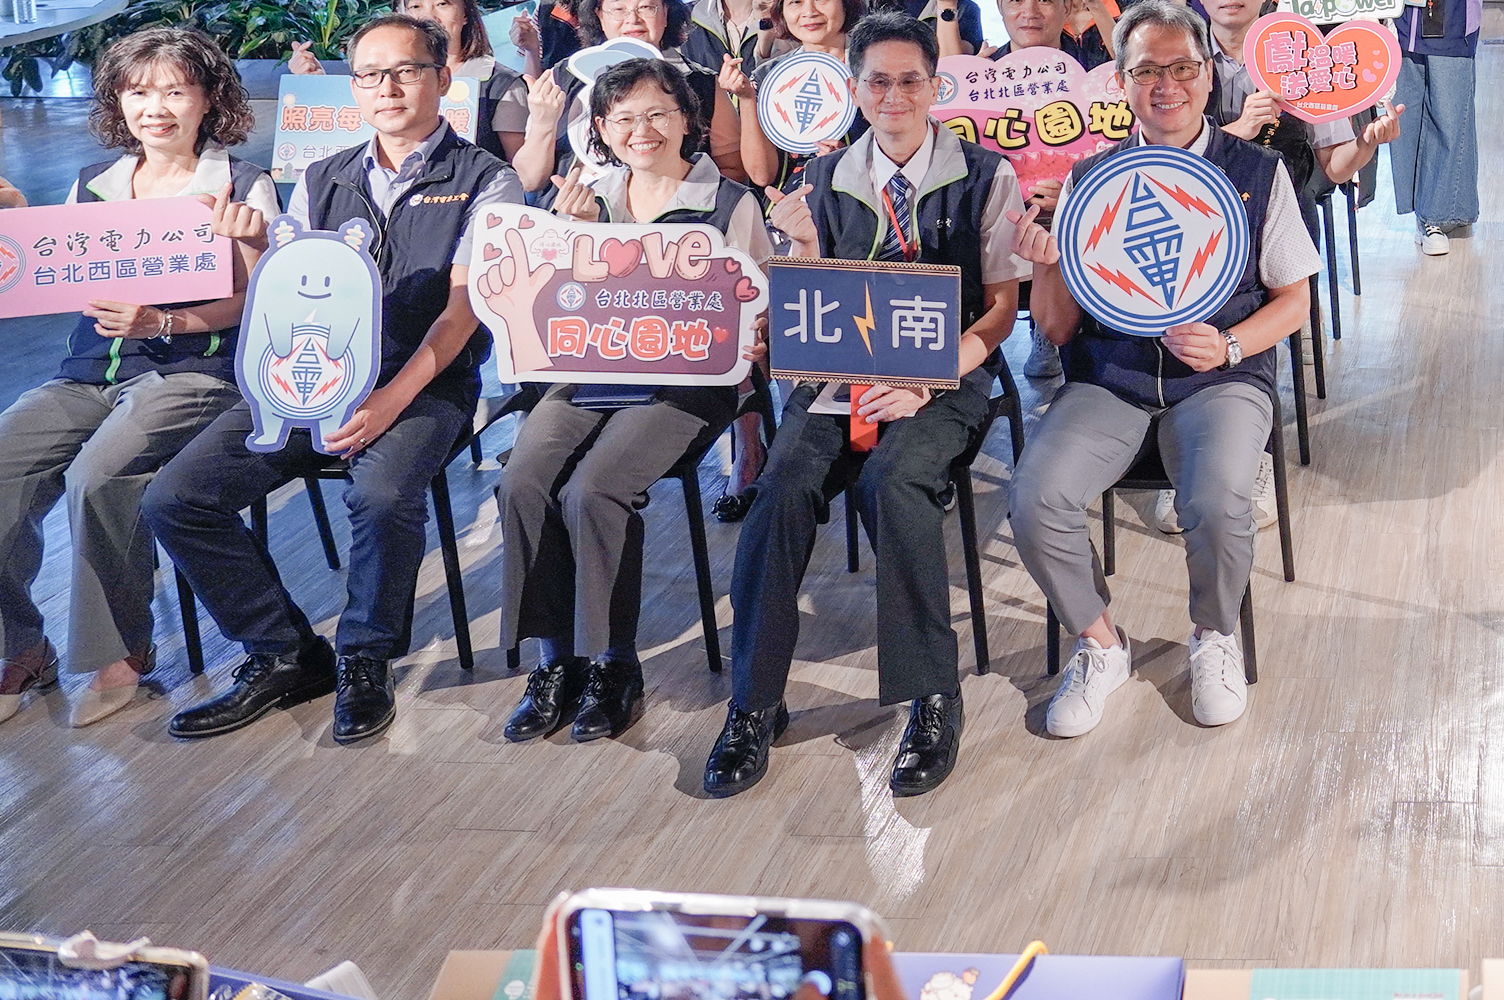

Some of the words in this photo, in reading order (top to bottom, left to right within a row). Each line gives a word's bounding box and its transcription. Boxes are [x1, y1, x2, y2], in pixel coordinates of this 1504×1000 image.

[1263, 31, 1357, 73] 獻溫暖
[966, 62, 1067, 84] 台灣電力公司
[1280, 67, 1356, 100] 送愛心
[968, 80, 1070, 102] 台北北區營業處
[33, 223, 216, 257] 台灣電力公司
[33, 252, 217, 286] 台北西區營業處
[595, 289, 725, 312] 台北北區營業處
[783, 289, 842, 344] 北
[889, 295, 948, 352] 南
[547, 316, 713, 361] 同心園地
